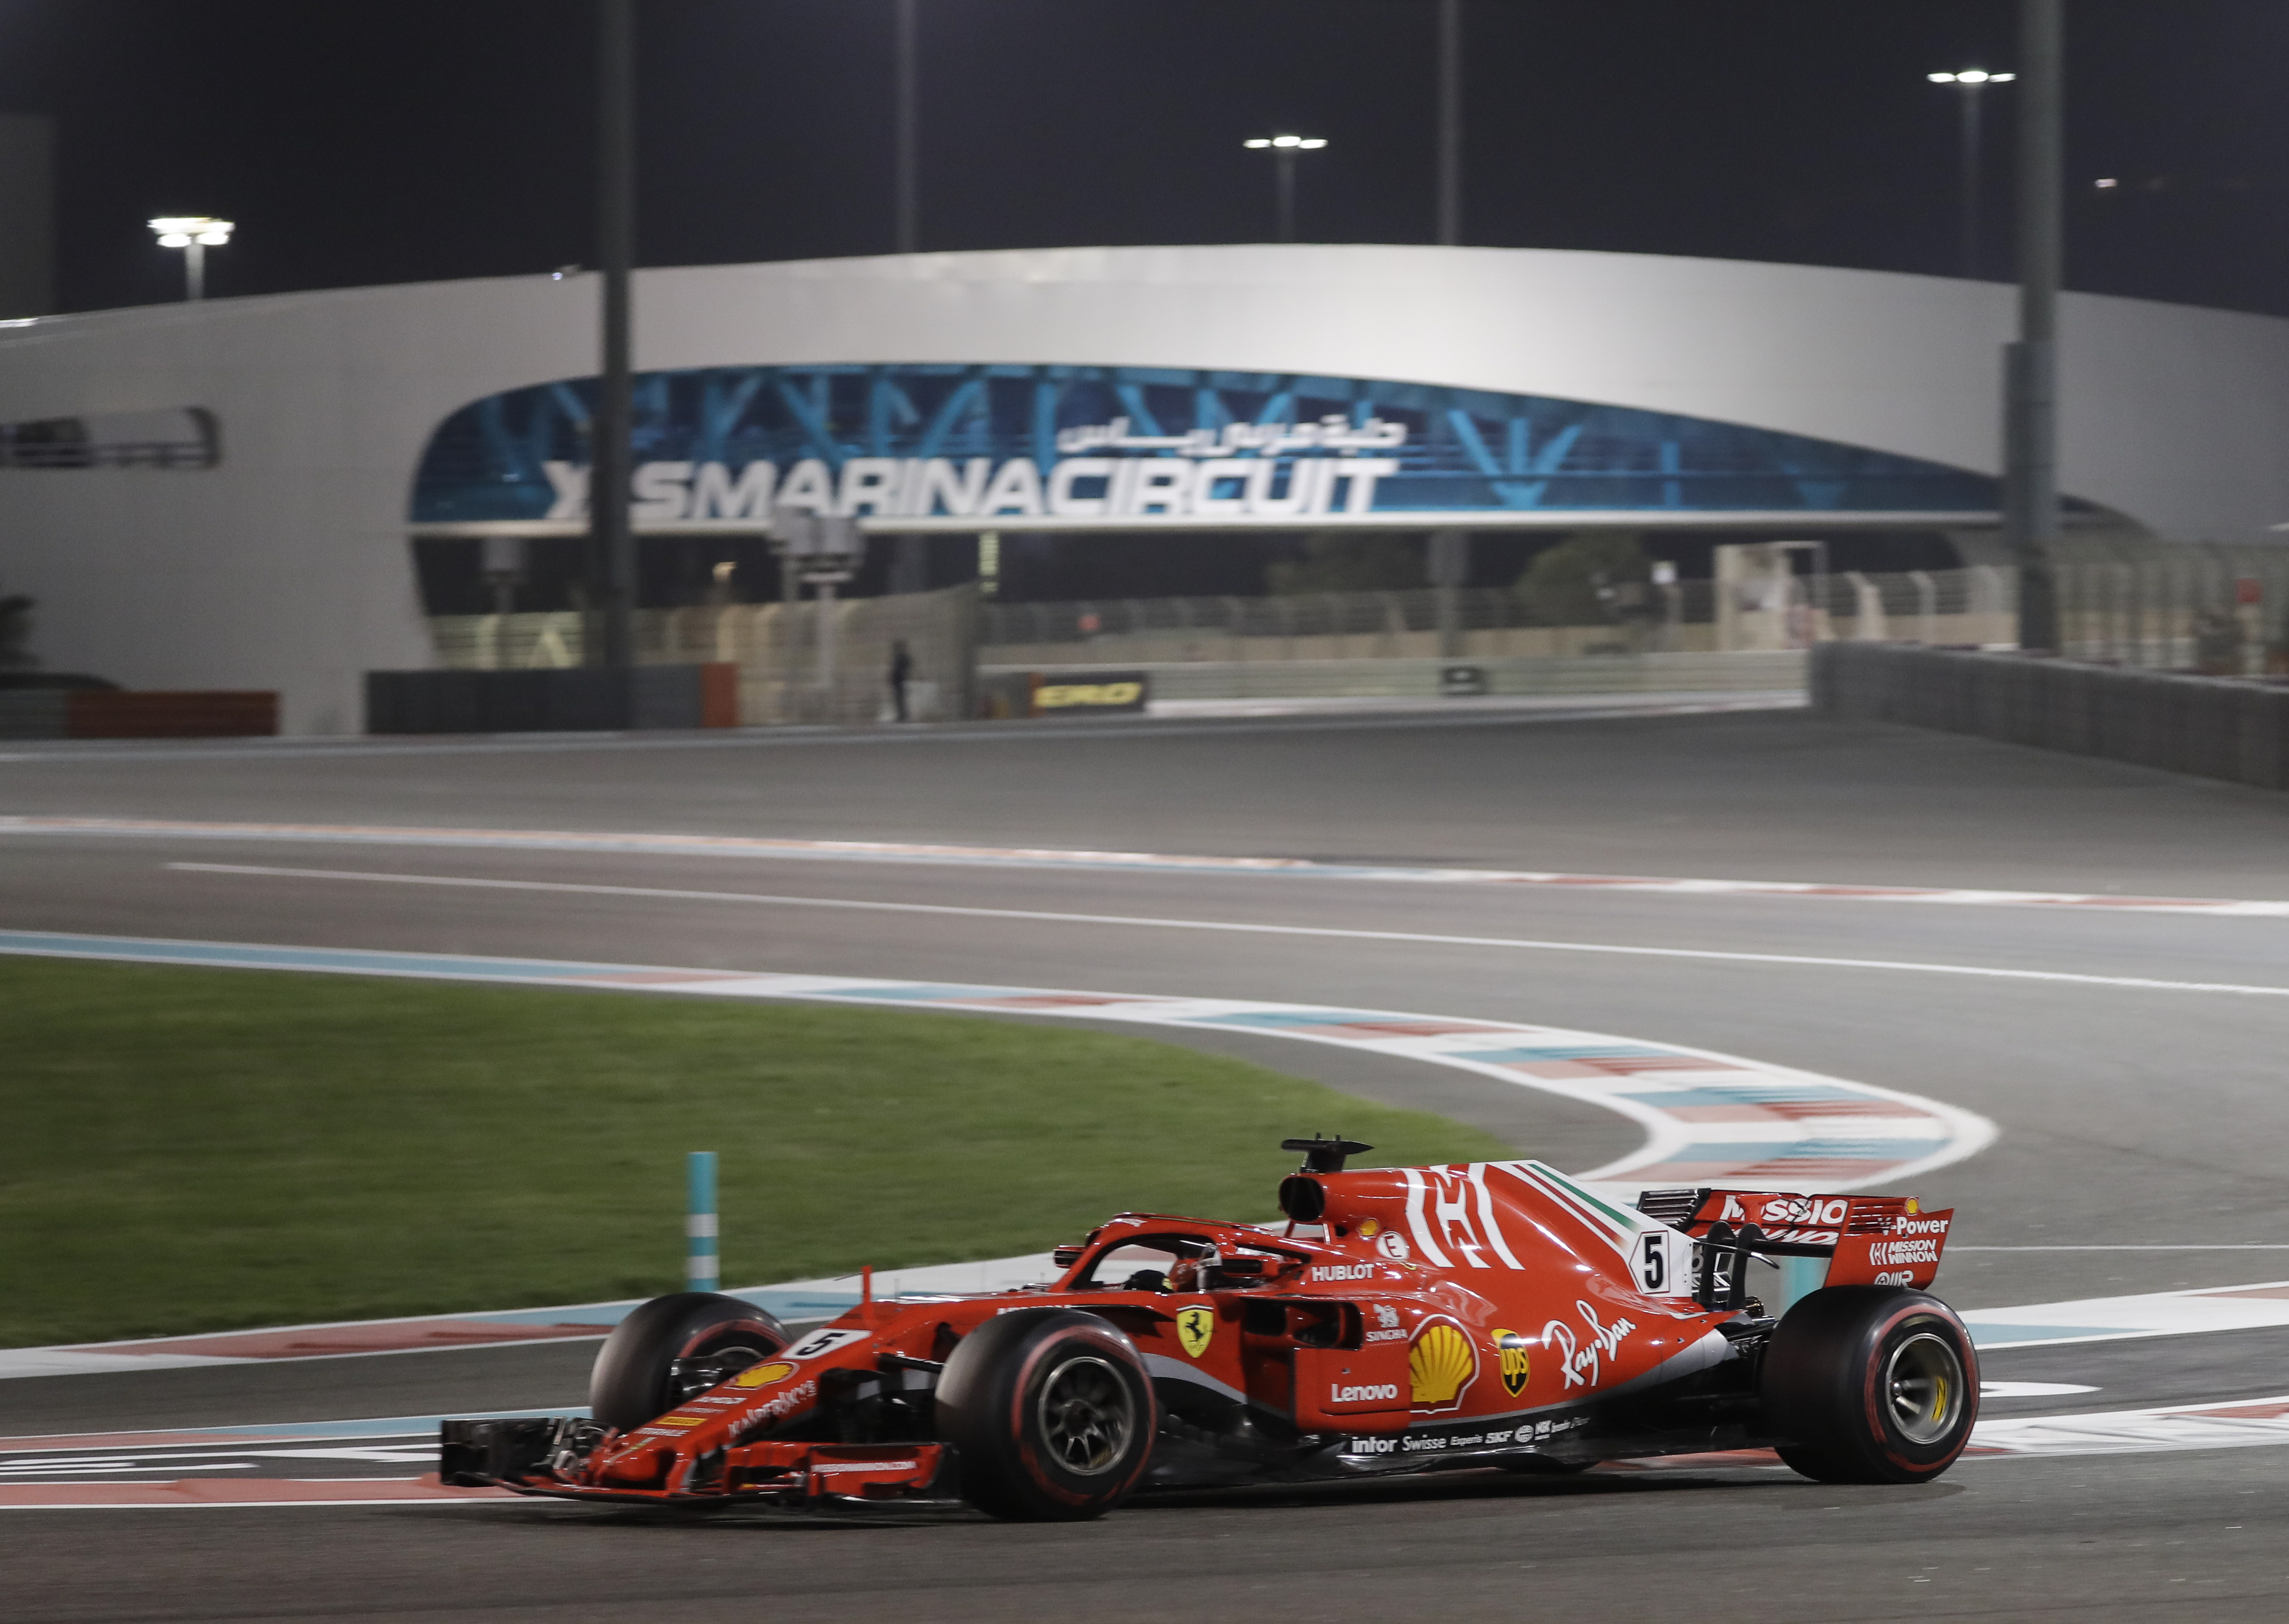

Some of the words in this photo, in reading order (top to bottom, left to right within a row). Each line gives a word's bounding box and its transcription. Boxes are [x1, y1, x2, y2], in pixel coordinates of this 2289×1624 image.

[690, 458, 1042, 517] MARINA
[1046, 457, 1400, 514] CIRCUIT
[1888, 1239, 1937, 1253] MISSION
[1644, 1235, 1663, 1289] 5
[1888, 1251, 1938, 1264] WINNOW
[1311, 1264, 1375, 1281] HUBLOT
[796, 1333, 848, 1356] 5
[1331, 1383, 1398, 1402] Lenovo
[1352, 1436, 1399, 1453] infor
[1402, 1434, 1447, 1451] Swisse
[1485, 1430, 1514, 1444] SKF
